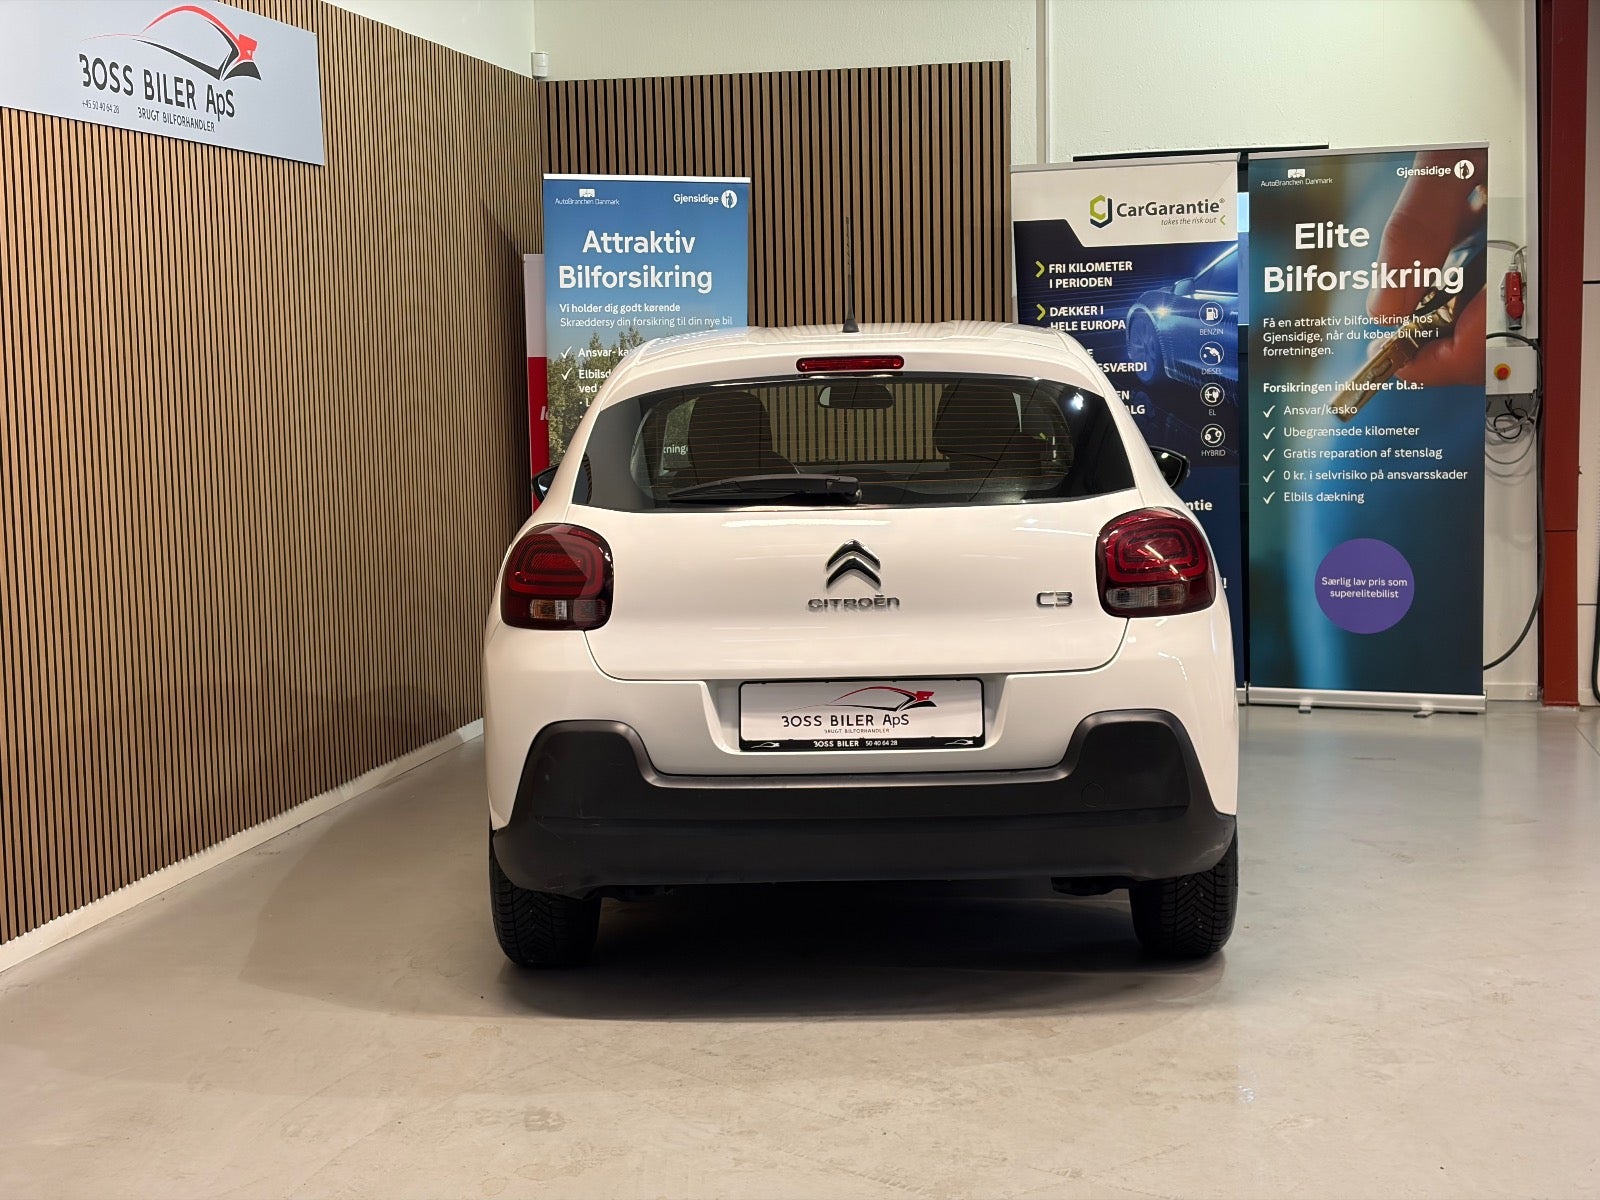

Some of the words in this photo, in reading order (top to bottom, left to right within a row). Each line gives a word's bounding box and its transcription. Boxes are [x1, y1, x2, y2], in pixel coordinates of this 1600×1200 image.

[143, 69, 197, 110] BILER
[206, 84, 235, 121] ApS
[162, 112, 215, 132] BILFORHANDLER
[1396, 166, 1451, 179] Gjensidige
[1260, 179, 1304, 187] AutoBranchen
[1305, 177, 1334, 185] Danmark
[673, 193, 719, 204] Gjensidige
[1161, 218, 1179, 226] takes
[1179, 217, 1191, 225] the
[1191, 216, 1204, 225] risk
[1295, 220, 1370, 250] Elite
[582, 230, 696, 253] Attraktiv
[1049, 263, 1066, 274] FRI
[1069, 261, 1133, 273] KILOMETER
[558, 265, 712, 294] Bilforsikring
[1049, 279, 1053, 289] I
[1055, 277, 1113, 288] PERIODEN
[1264, 260, 1464, 294] Bilforsikring
[559, 304, 570, 313] Vi
[571, 304, 602, 313] holder
[604, 304, 618, 315] dig
[620, 304, 642, 315] godt
[643, 303, 681, 312] kørende
[1050, 306, 1098, 317] DÆKKER
[1100, 305, 1104, 315] I
[560, 317, 615, 329] Skræddersy
[616, 317, 631, 326] din
[633, 316, 675, 328] forsikring
[677, 316, 687, 326] til
[688, 316, 703, 326] din
[705, 318, 720, 328] nye
[722, 316, 733, 325] bil
[1050, 321, 1078, 331] HELE
[1080, 319, 1126, 330] EUROPA
[1263, 318, 1276, 328] Få
[1278, 319, 1292, 328] en
[1294, 317, 1342, 327] attraktiv
[1344, 314, 1410, 328] bilforsikring
[1412, 314, 1433, 324] hos
[1200, 328, 1224, 336] BENZIN
[1263, 331, 1323, 344] Gjensidige,
[1326, 330, 1345, 341] når
[1346, 330, 1361, 340] du
[1363, 329, 1395, 340] køber
[1398, 328, 1411, 339] bil
[1414, 328, 1433, 338] her
[1435, 328, 1439, 338] i
[578, 347, 616, 357] Ansvar-
[618, 347, 631, 357] ka
[1086, 348, 1094, 358] E
[1263, 346, 1334, 358] forretningen.
[578, 369, 611, 379] Elbilsd
[1201, 367, 1223, 375] DIESEL
[579, 384, 597, 393] ved
[1263, 382, 1332, 395] Forsikringen
[1334, 381, 1393, 392] inkluderer
[1396, 381, 1424, 391] bl.a.:
[1283, 404, 1358, 416] Ansvar/kasko
[1283, 427, 1362, 440] Ubegrænsede
[1365, 426, 1420, 436] kilometer
[1283, 448, 1317, 459] Gratis
[1319, 449, 1378, 461] reparation
[1380, 448, 1392, 458] af
[1394, 447, 1443, 460] stenslag
[1283, 470, 1291, 481] 0
[1293, 470, 1307, 481] kr.
[1309, 470, 1313, 480] i
[1315, 470, 1368, 480] selvrisiko
[1370, 469, 1384, 482] på
[1386, 470, 1468, 480] ansvarsskader
[1283, 492, 1314, 502] Elbils
[1316, 491, 1365, 504] dækning
[1186, 499, 1213, 511] ntie
[1321, 577, 1352, 588] Særlig
[1353, 577, 1366, 586] lav
[1368, 577, 1386, 588] pris
[1388, 578, 1408, 587] som
[1036, 591, 1073, 608] C3
[1329, 589, 1399, 600] superelitebilist
[830, 714, 874, 727] BILER
[882, 714, 910, 728] ApS
